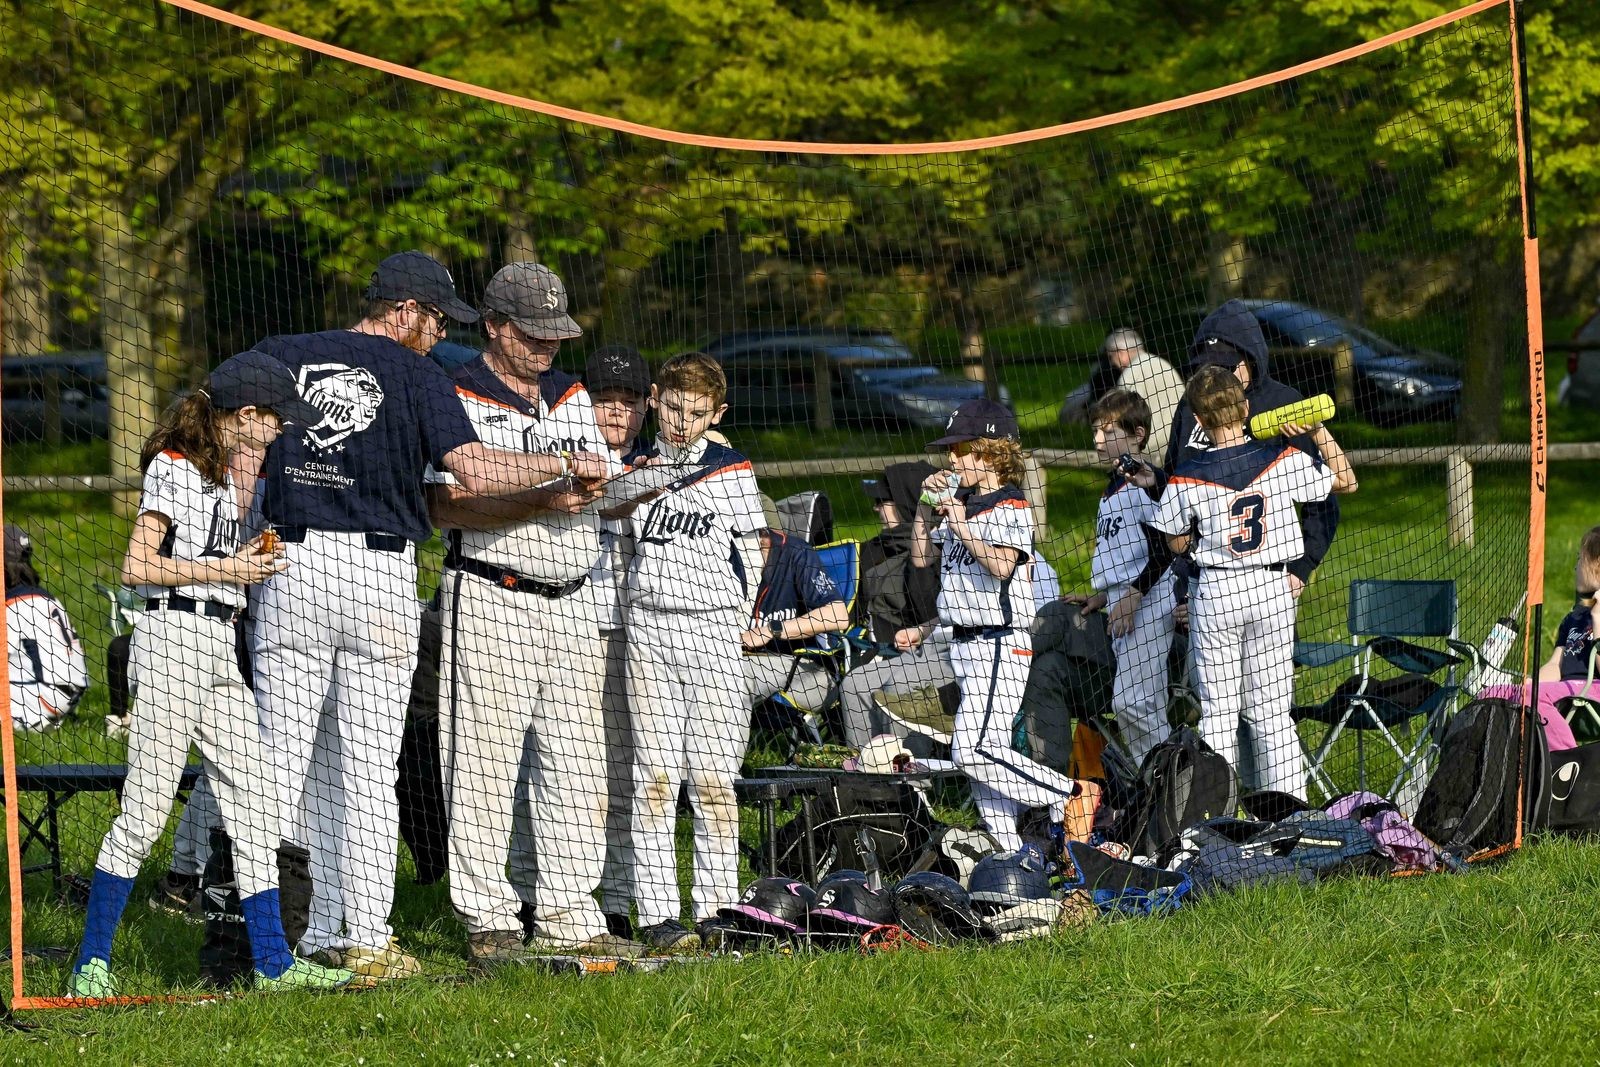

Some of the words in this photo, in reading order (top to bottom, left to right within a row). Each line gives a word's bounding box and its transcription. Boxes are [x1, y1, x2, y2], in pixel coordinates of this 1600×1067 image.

[540, 287, 559, 310] S
[986, 423, 996, 434] 14
[304, 462, 338, 474] CENTRE
[638, 496, 716, 546] Lions
[1228, 490, 1267, 557] 3
[818, 889, 836, 908] S
